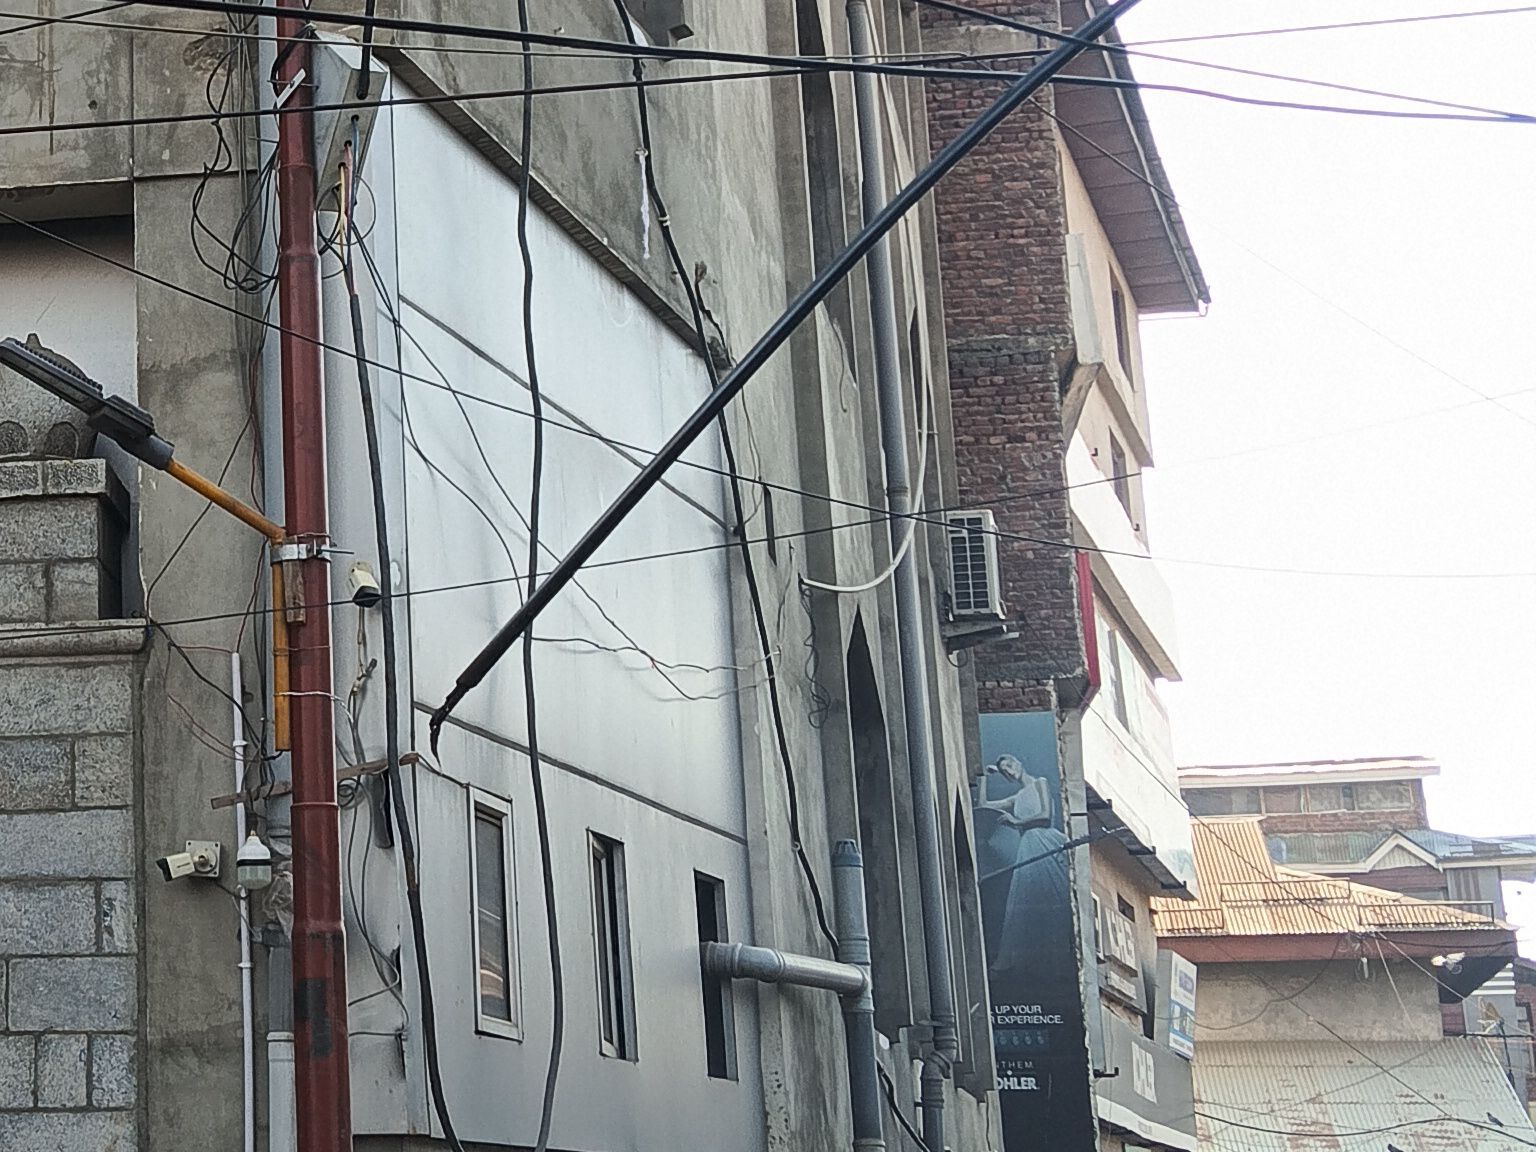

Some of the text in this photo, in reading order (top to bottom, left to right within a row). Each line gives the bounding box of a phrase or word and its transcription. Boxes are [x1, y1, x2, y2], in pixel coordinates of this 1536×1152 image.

[995, 1005, 1042, 1014] UP YOUR
[997, 1015, 1064, 1024] EXPERIENCE.
[996, 1061, 1034, 1069] THEM
[996, 1077, 1037, 1090] OHLER
